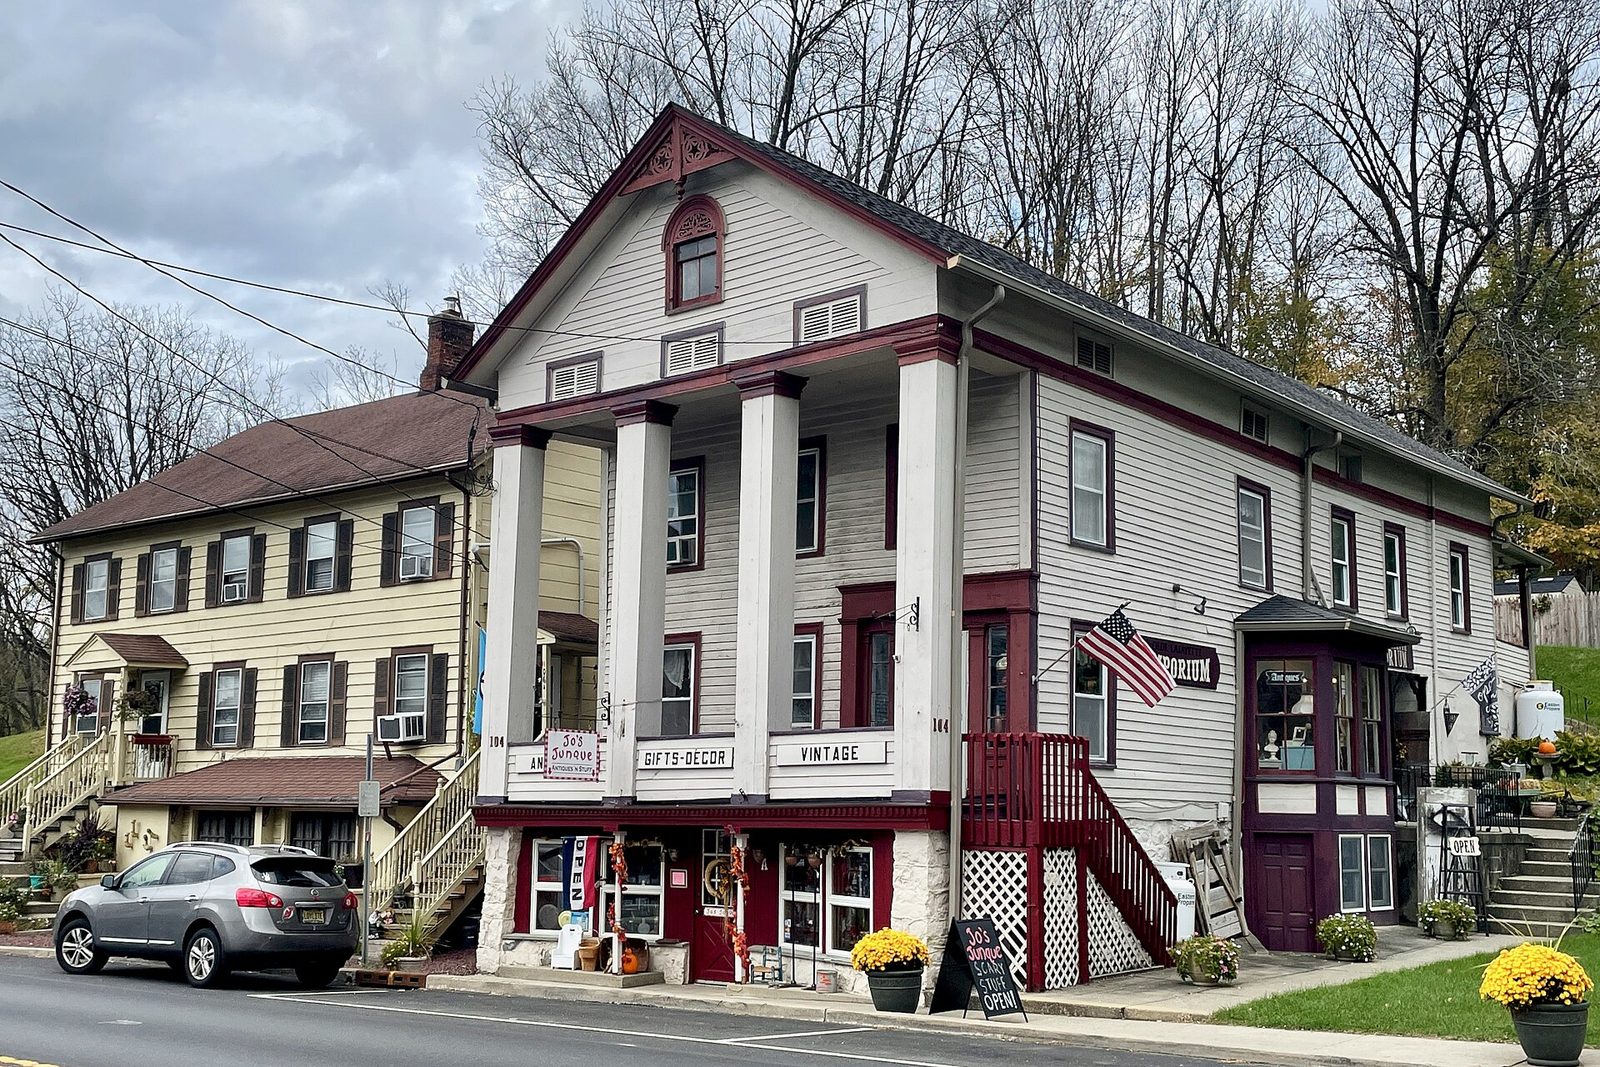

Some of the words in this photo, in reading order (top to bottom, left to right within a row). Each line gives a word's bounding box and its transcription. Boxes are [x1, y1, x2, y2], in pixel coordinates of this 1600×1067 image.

[1271, 672, 1300, 683] Antques
[933, 718, 949, 733] 104
[489, 735, 505, 748] 104
[563, 734, 583, 747] Jo's
[801, 745, 859, 762] VINTAGE
[1453, 839, 1476, 854] OPEN
[571, 840, 585, 901] OPEN
[966, 926, 991, 945] Jo's
[973, 960, 1006, 976] SCARY
[979, 976, 1006, 994] STUFF
[984, 990, 1018, 1011] OPEN!
